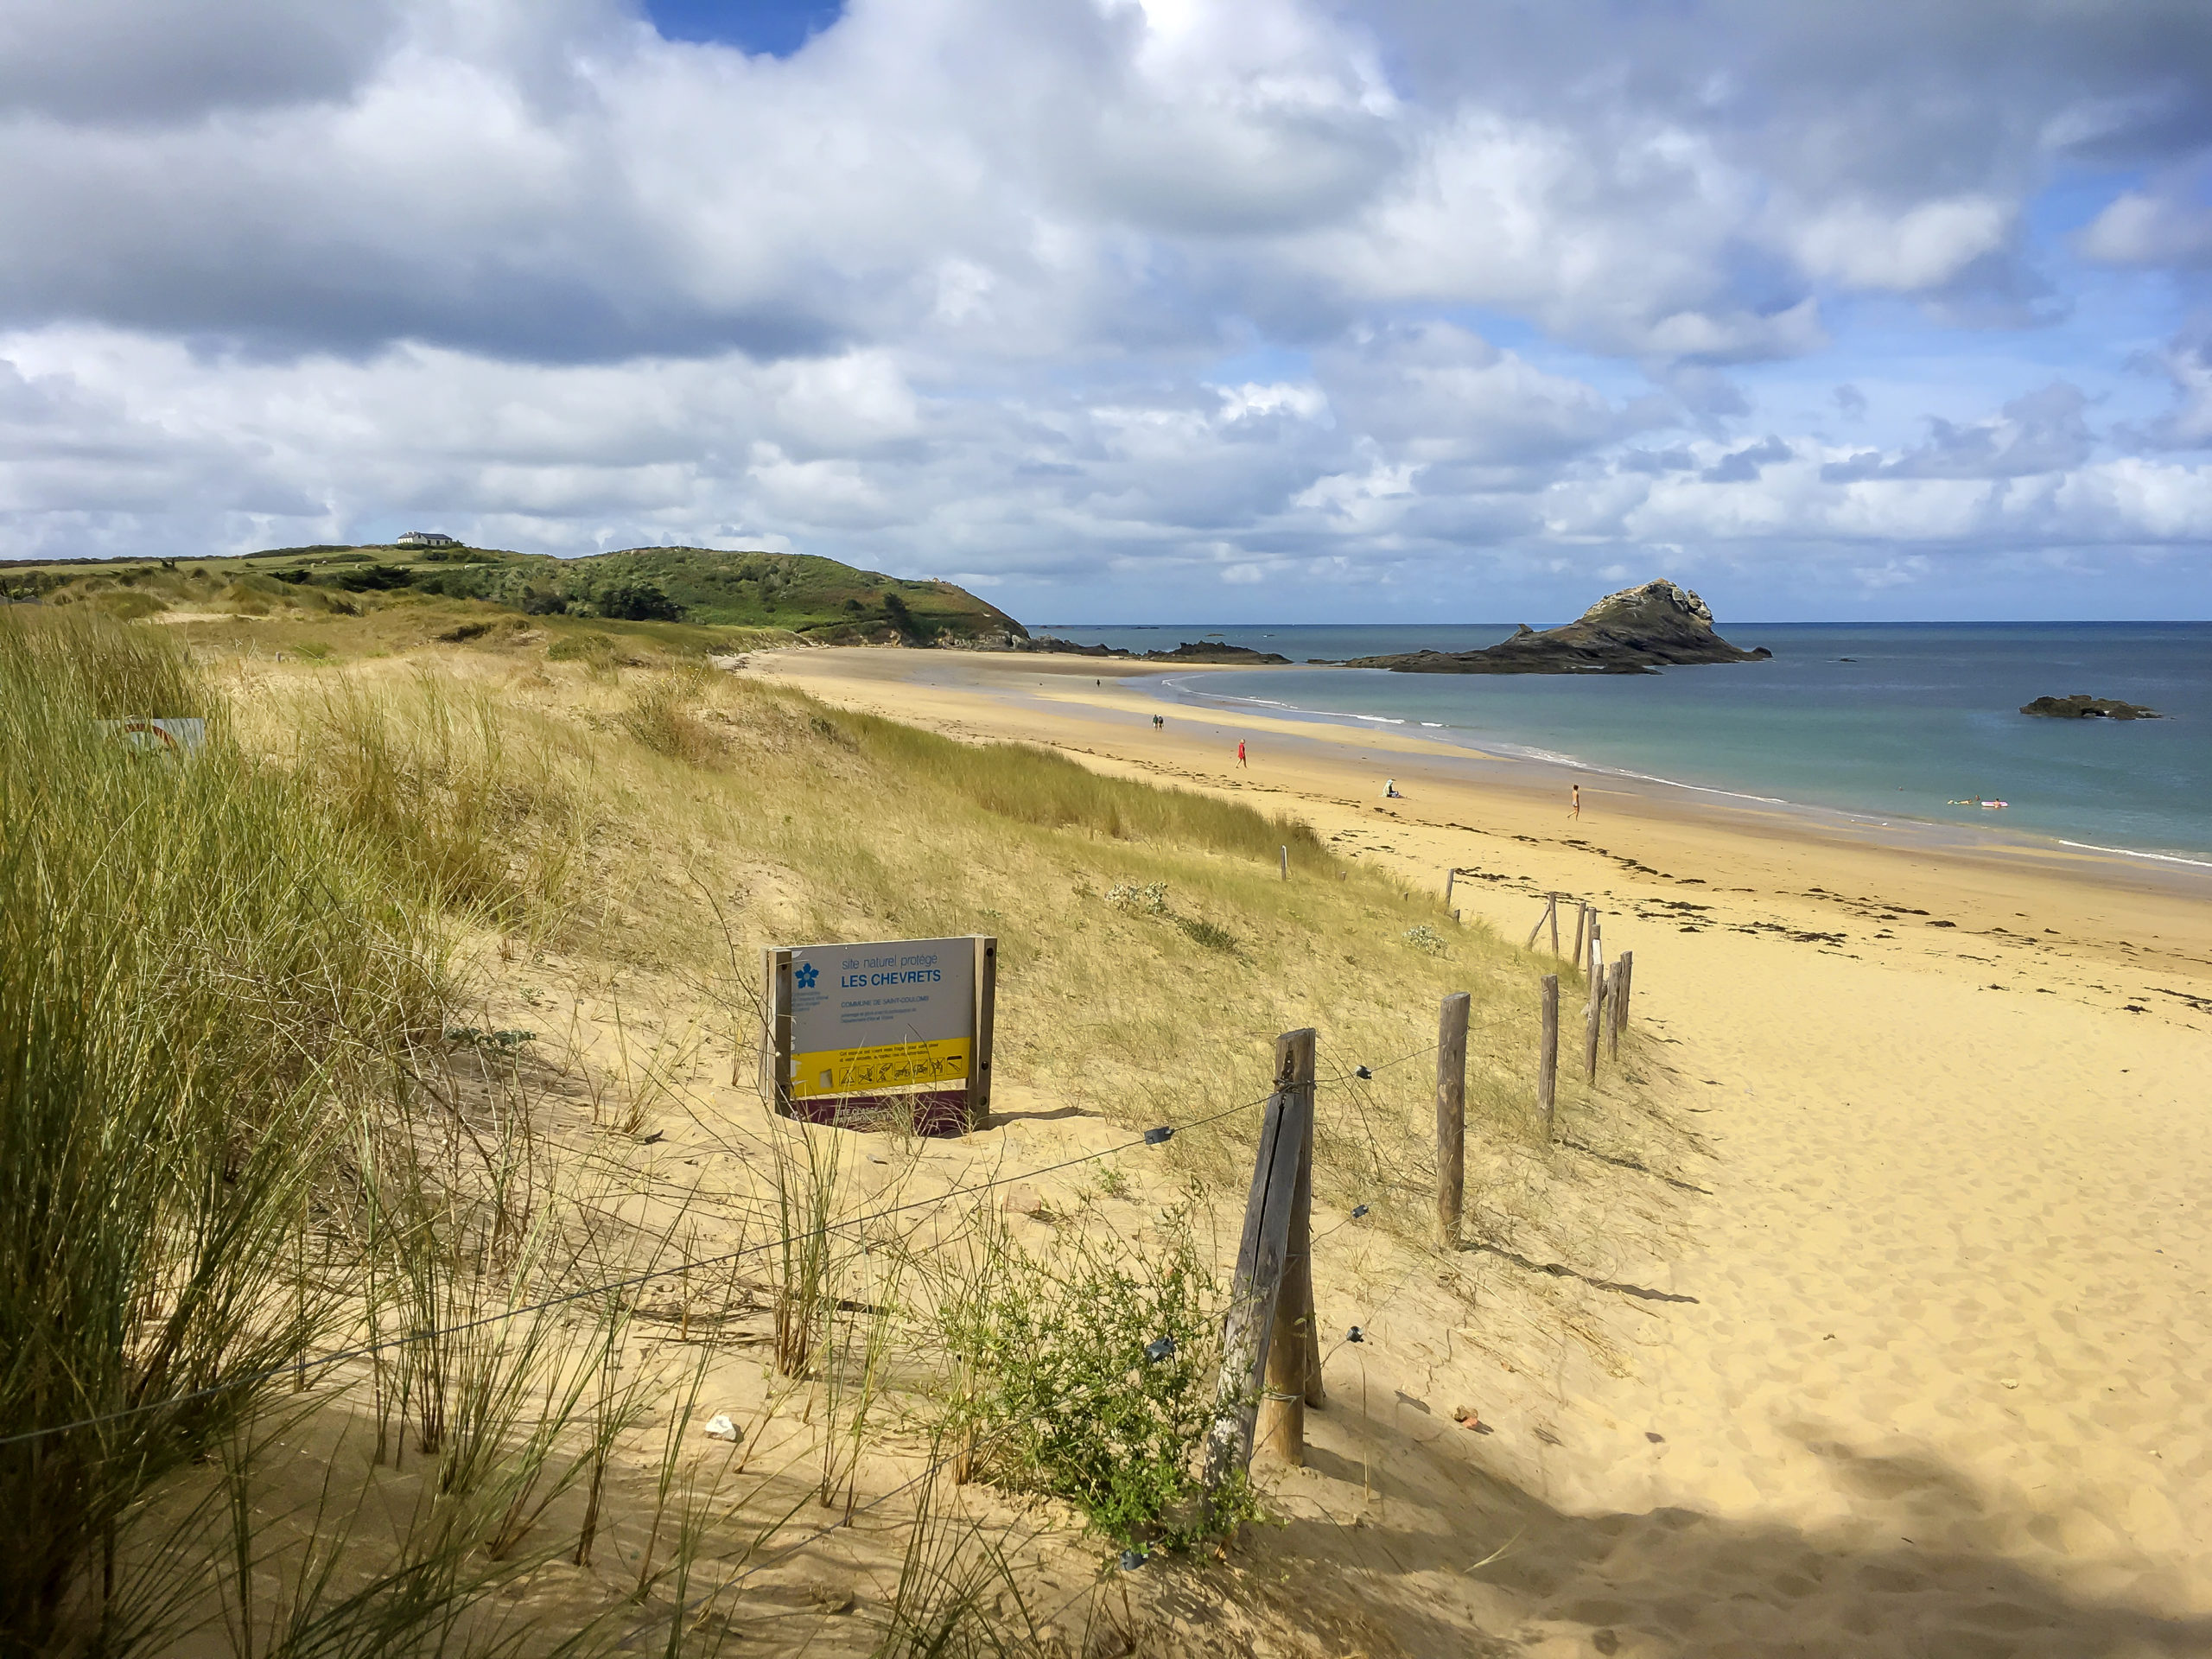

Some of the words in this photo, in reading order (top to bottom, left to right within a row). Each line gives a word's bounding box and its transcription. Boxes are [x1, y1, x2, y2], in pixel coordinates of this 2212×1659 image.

[842, 957, 860, 970] site
[863, 954, 897, 969] naturel
[900, 953, 938, 969] protégé
[842, 974, 868, 988] LES
[871, 969, 941, 987] CHEVRETS
[841, 1000, 872, 1008] COMMUNE
